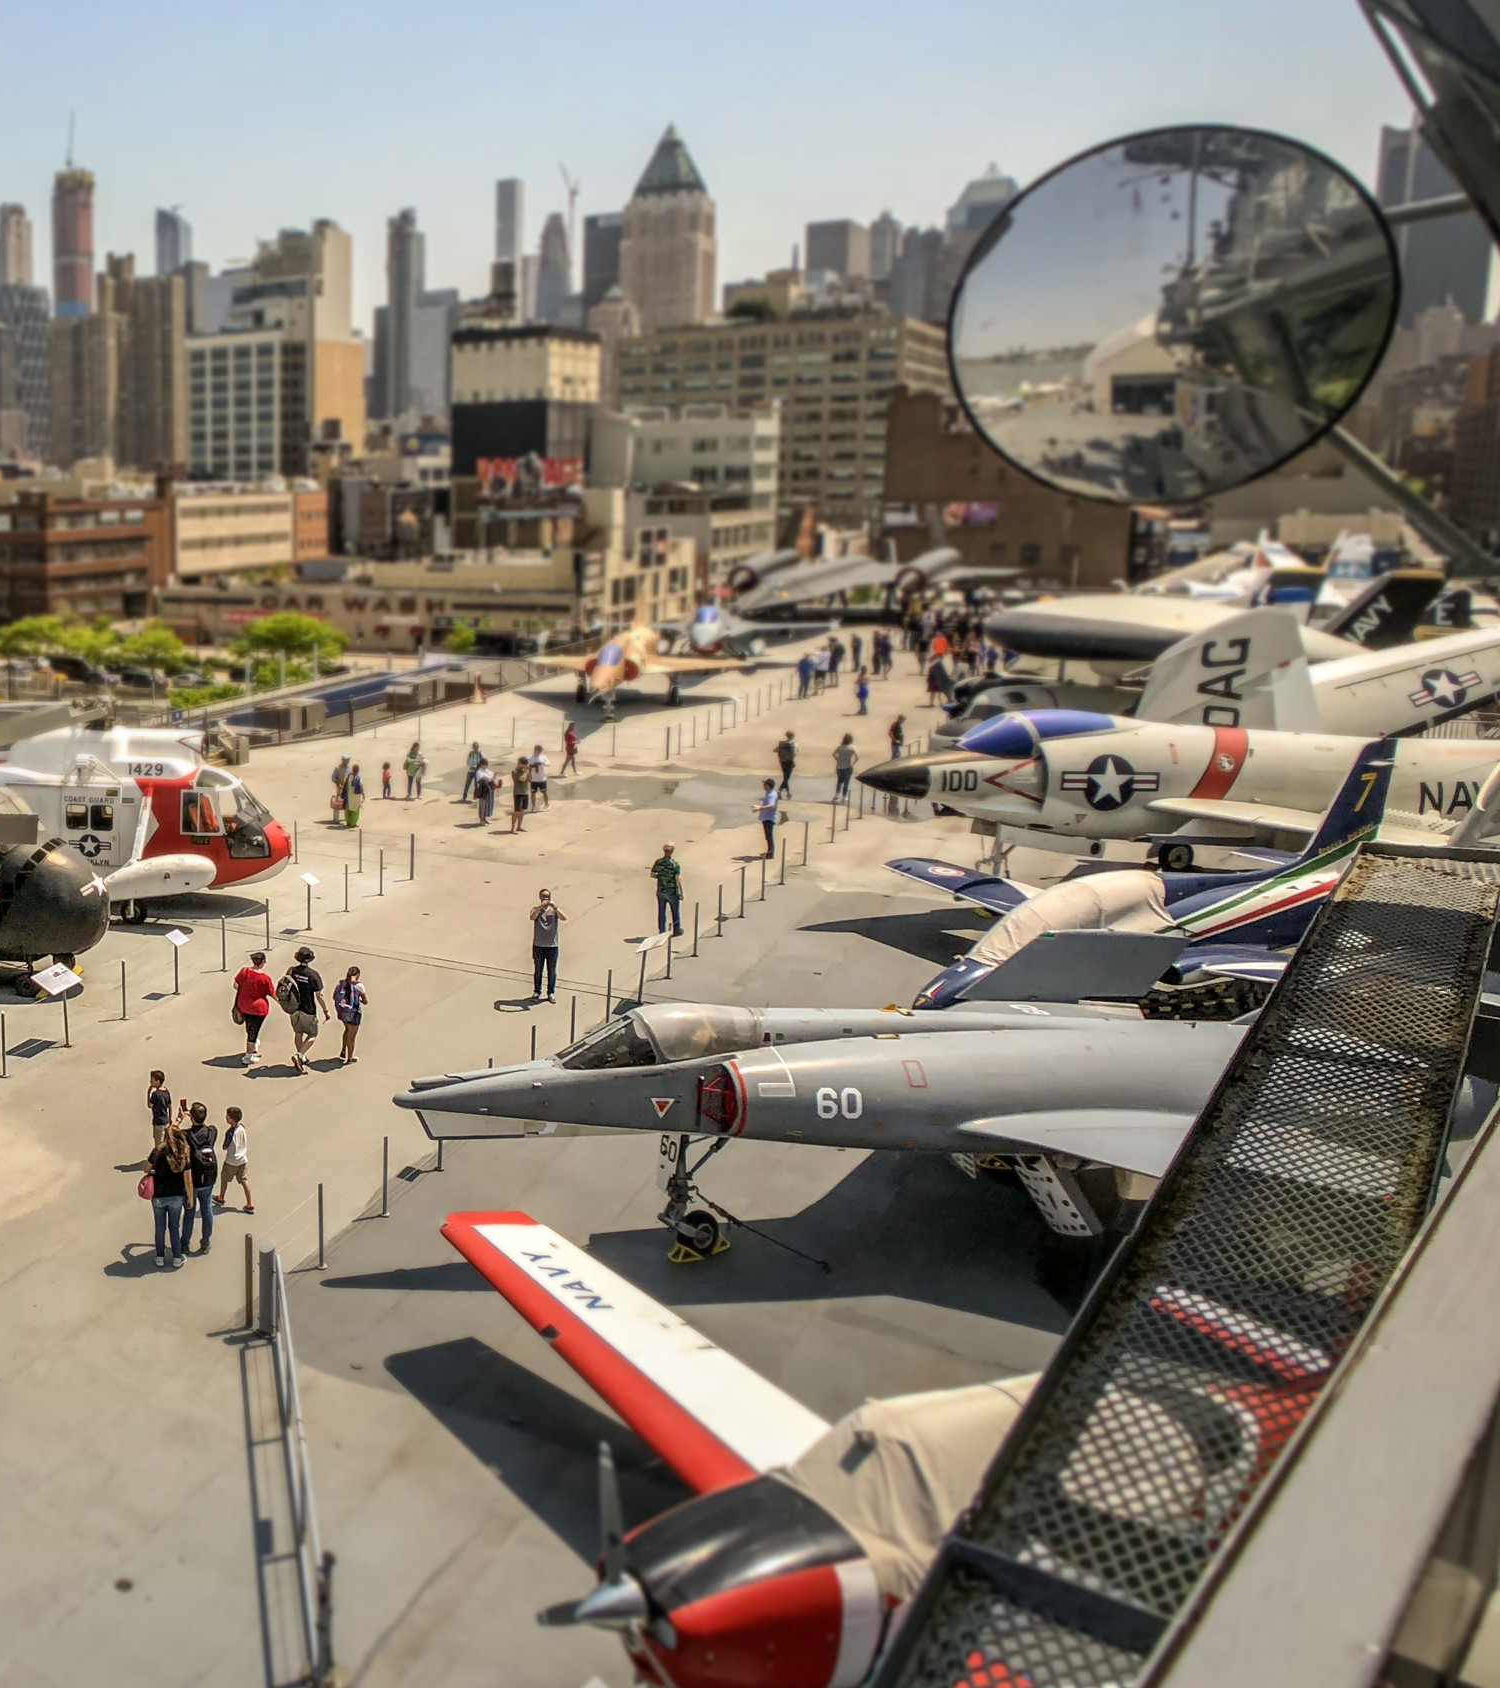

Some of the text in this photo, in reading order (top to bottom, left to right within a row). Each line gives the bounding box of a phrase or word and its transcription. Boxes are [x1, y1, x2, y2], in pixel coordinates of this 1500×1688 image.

[127, 762, 164, 776] 1429
[941, 769, 978, 792] 100
[1353, 772, 1378, 813] 7
[816, 1087, 863, 1119] 60
[660, 1134, 678, 1162] 60
[520, 1251, 615, 1310] NAVY
